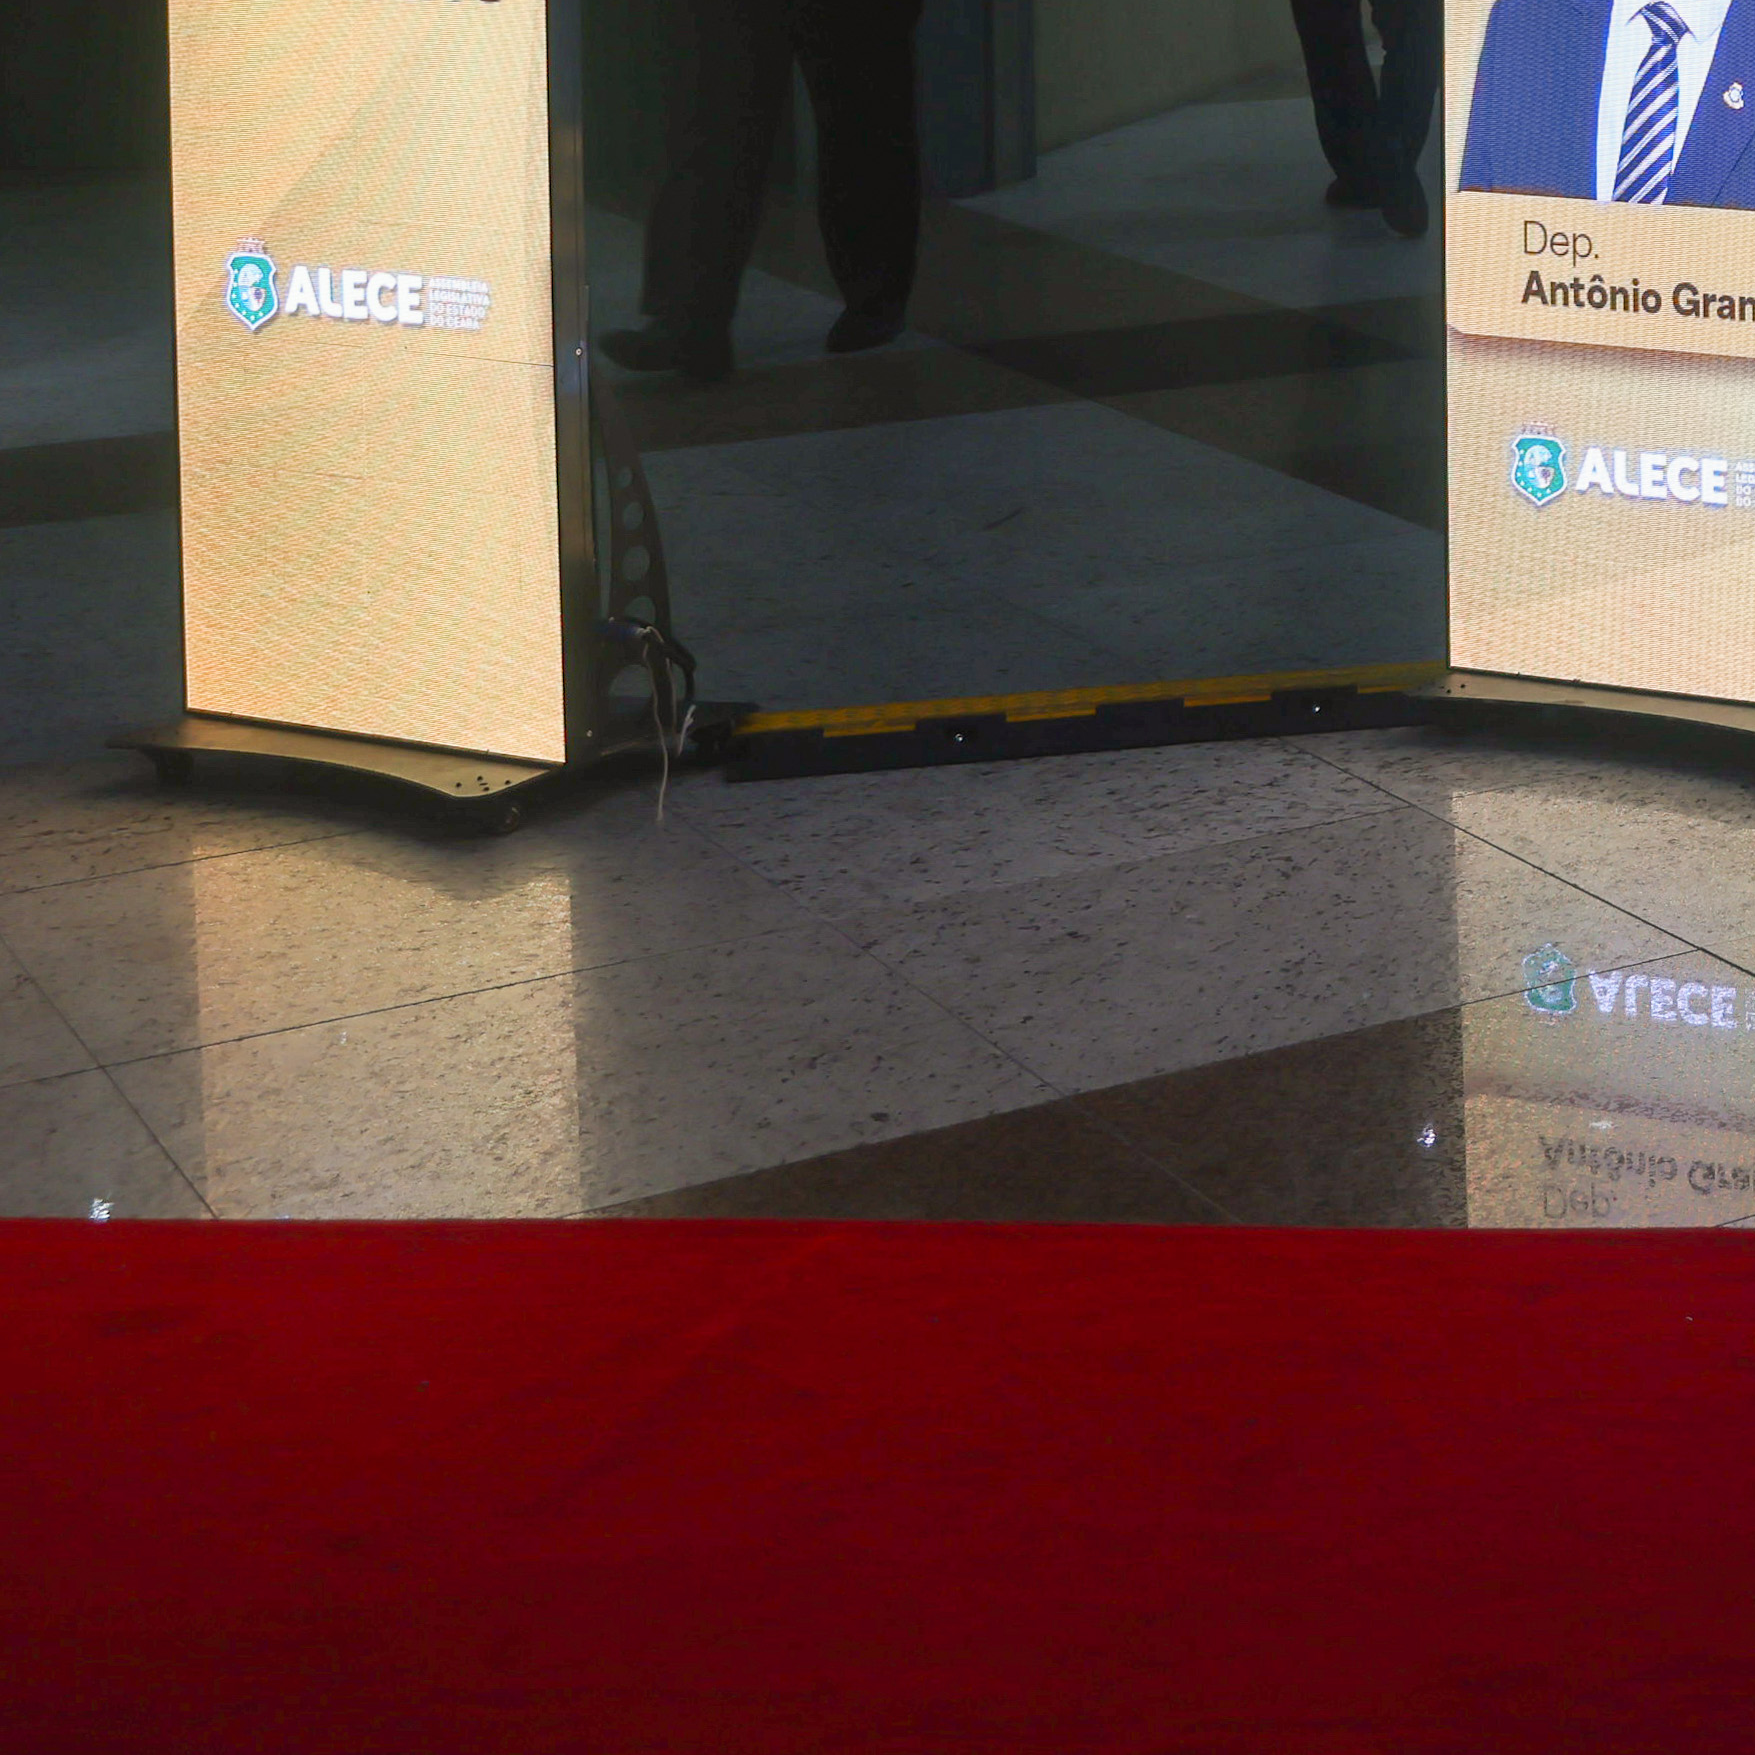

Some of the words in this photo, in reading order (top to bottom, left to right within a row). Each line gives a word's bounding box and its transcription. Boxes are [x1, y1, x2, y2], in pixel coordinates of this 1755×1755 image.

[1523, 219, 1600, 266] Dep.
[285, 265, 424, 326] ALECE
[1521, 270, 1662, 314] Antônio
[1575, 448, 1729, 505] ALECE
